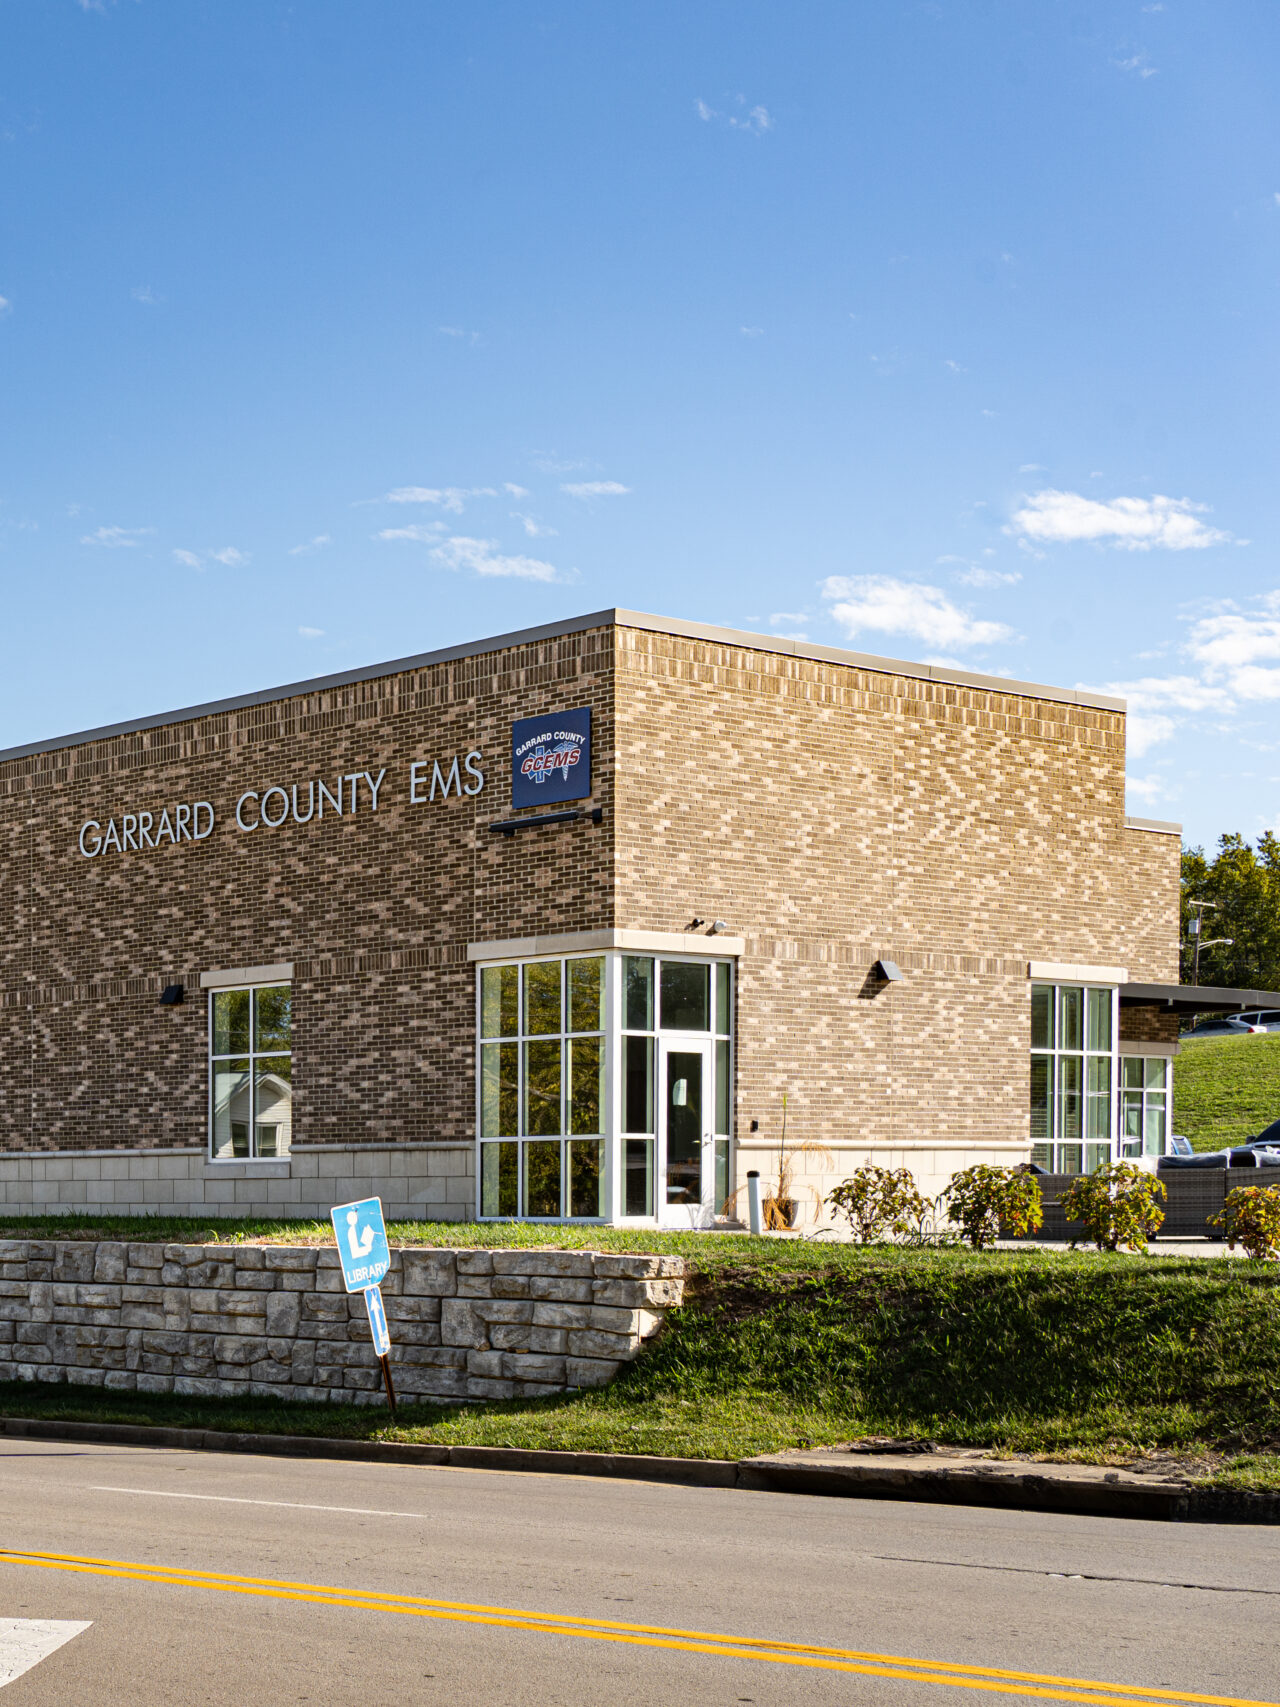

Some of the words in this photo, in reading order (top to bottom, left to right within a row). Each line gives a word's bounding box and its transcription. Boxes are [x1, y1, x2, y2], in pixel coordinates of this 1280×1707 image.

[516, 733, 552, 756] GARRARD
[554, 731, 586, 744] COUNTY
[521, 749, 581, 774] GCEMS
[78, 802, 215, 859] GARRARD
[235, 768, 387, 832] COUNTY
[410, 751, 485, 803] EMS
[347, 1261, 388, 1284] LIBRARY
